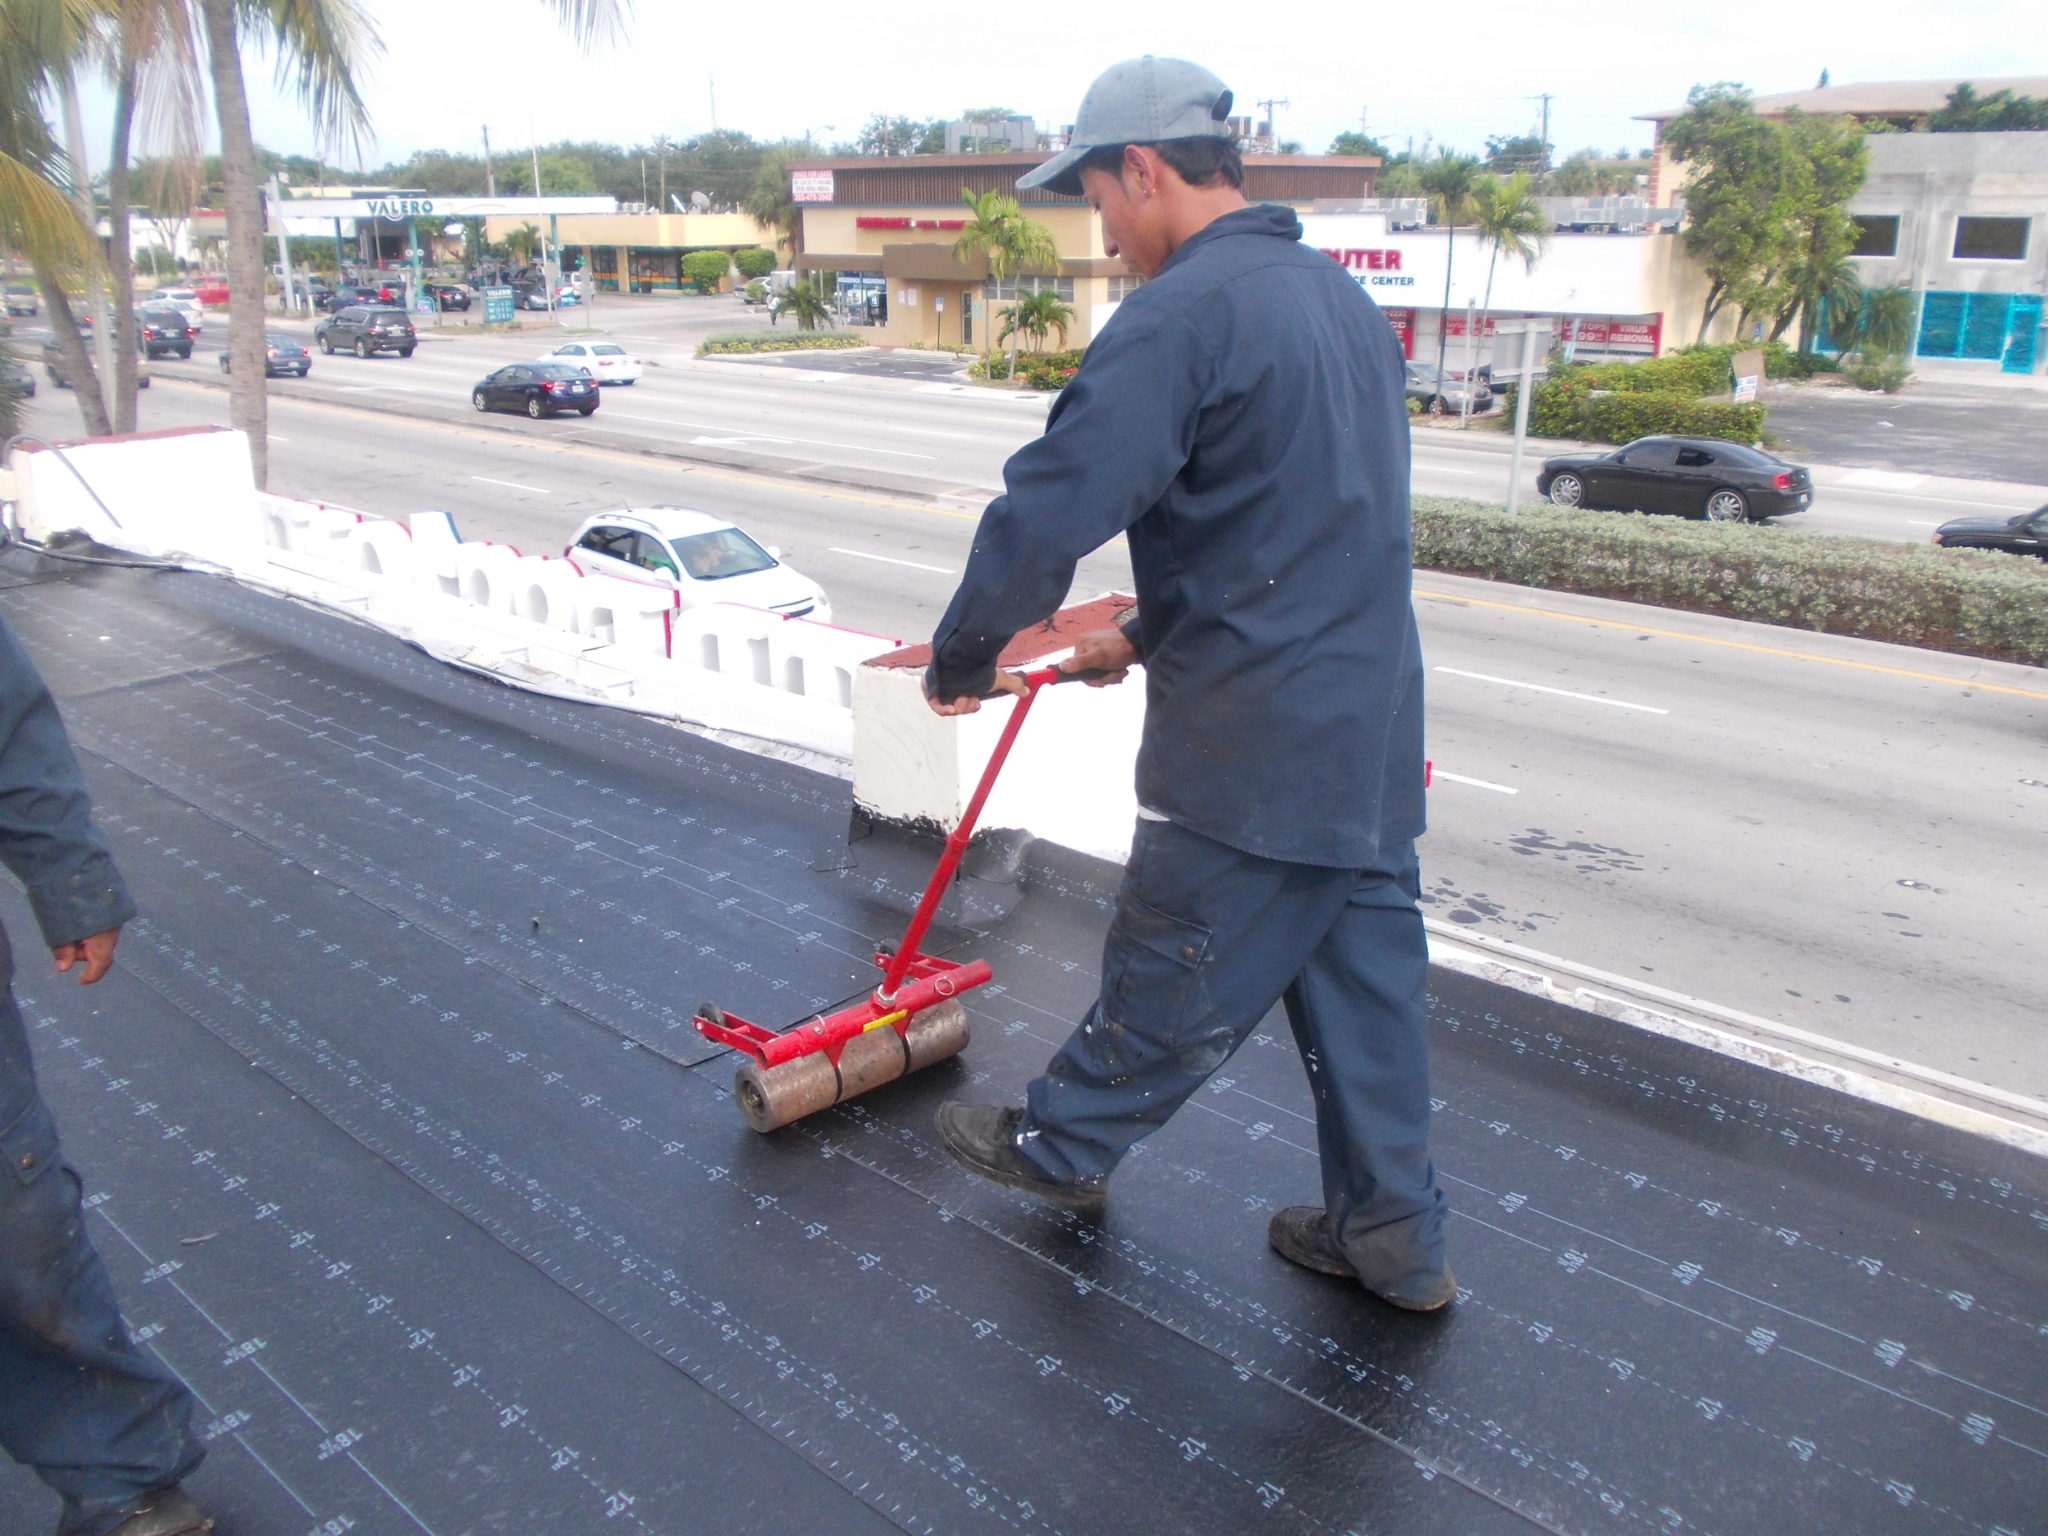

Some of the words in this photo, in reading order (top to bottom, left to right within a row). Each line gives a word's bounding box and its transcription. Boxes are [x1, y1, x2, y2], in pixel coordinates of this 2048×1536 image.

[366, 200, 433, 216] VALERO
[1371, 276, 1415, 286] CENTER
[1619, 324, 1649, 334] VIRUS
[1609, 333, 1655, 343] REMOVAL
